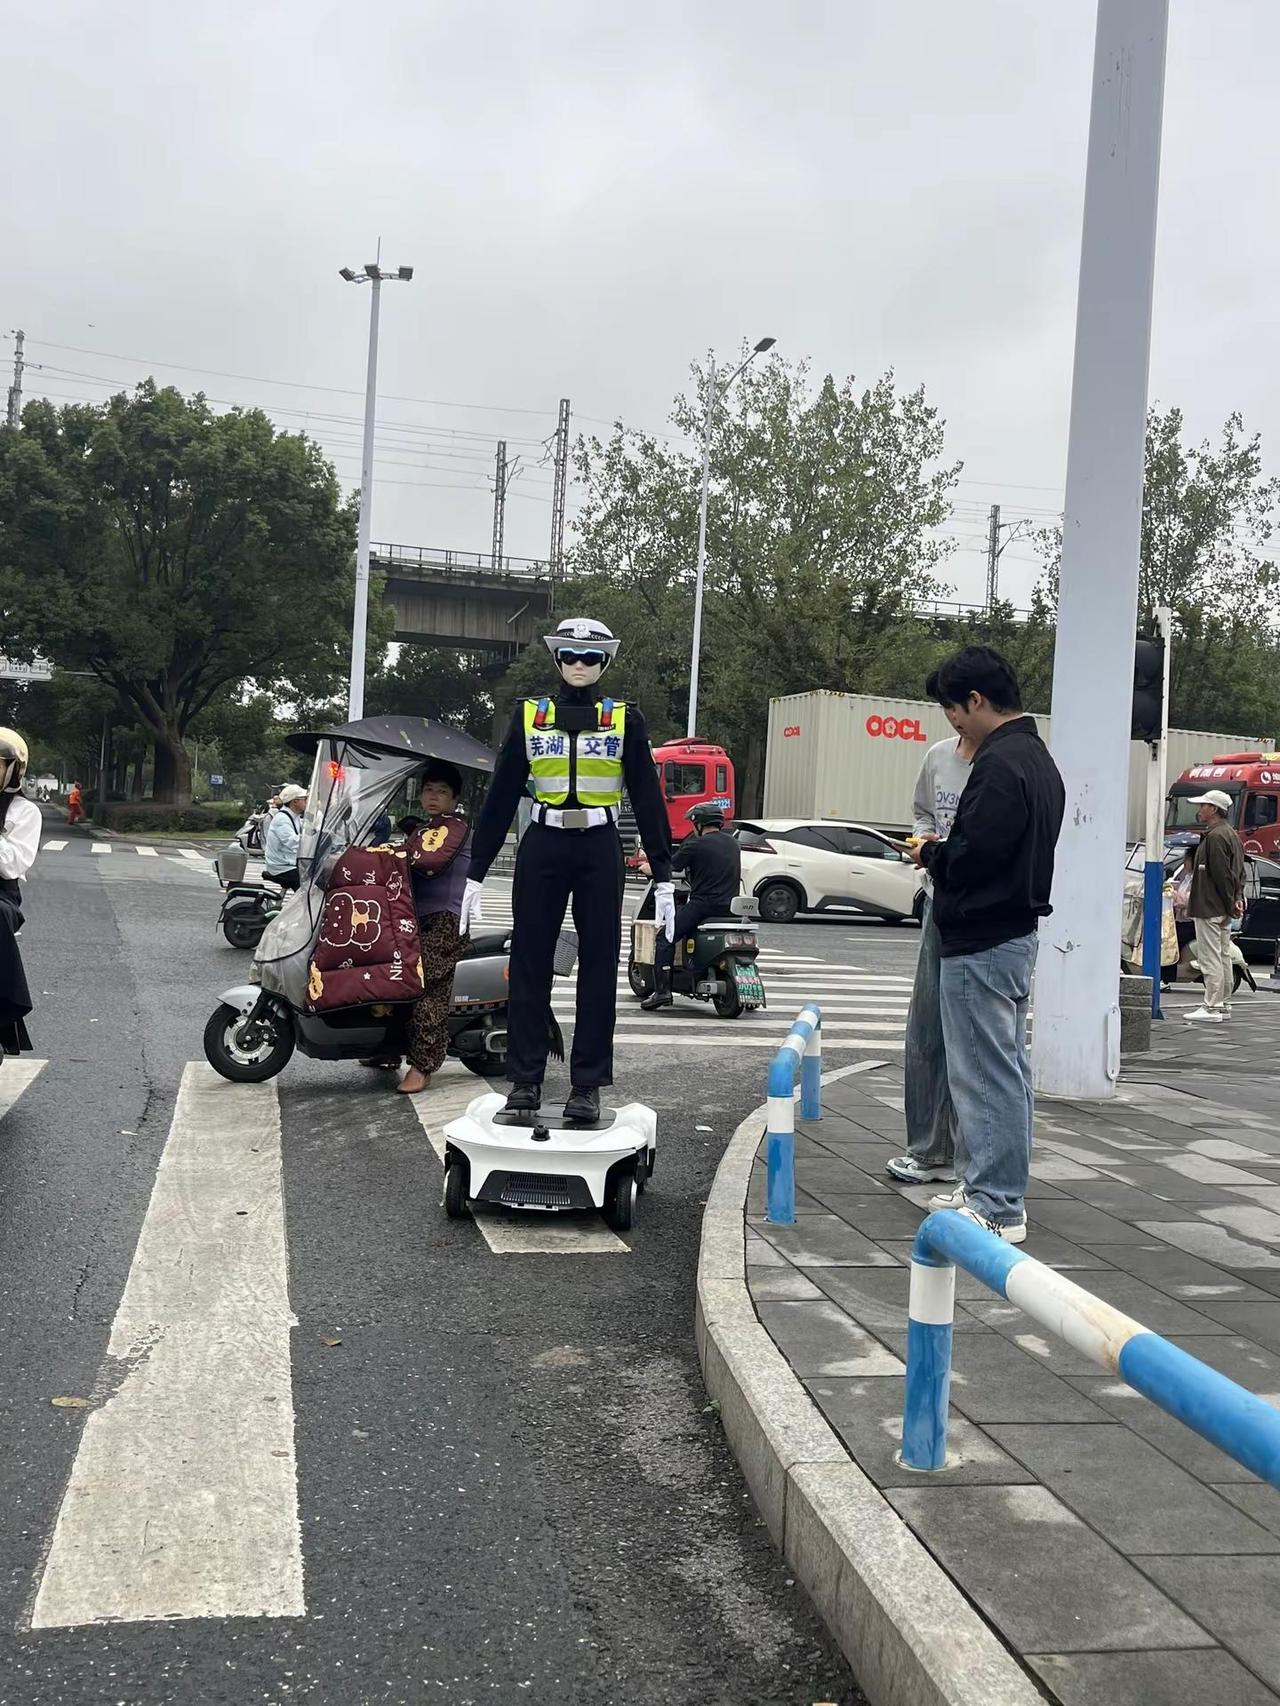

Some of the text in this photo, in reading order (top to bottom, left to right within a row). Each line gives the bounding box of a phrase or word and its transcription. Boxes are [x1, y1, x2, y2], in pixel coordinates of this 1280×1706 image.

[866, 715, 927, 741] OOCL
[530, 736, 620, 756] 芜湖 交管
[389, 950, 403, 980] Nice
